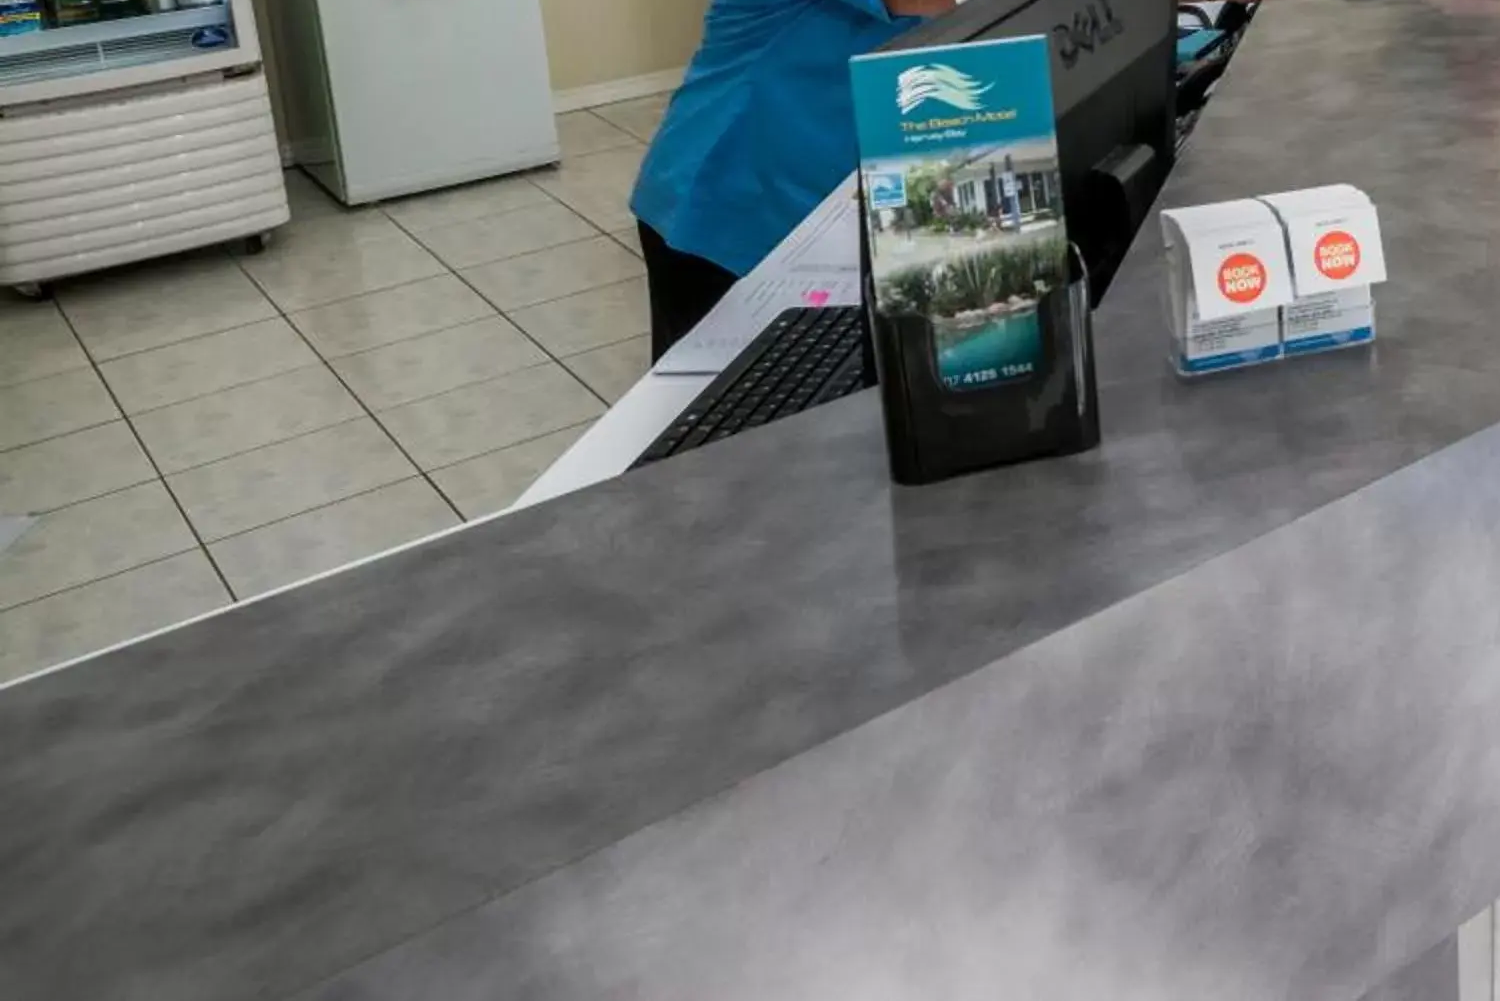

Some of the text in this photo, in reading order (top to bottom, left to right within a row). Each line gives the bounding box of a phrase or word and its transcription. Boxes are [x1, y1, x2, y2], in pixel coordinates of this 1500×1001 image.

[899, 120, 928, 132] The
[975, 108, 1018, 123] Motel
[1320, 243, 1353, 259] BOOK
[1321, 254, 1356, 270] NOW
[1223, 263, 1259, 280] BOOK
[1225, 277, 1261, 294] NOW
